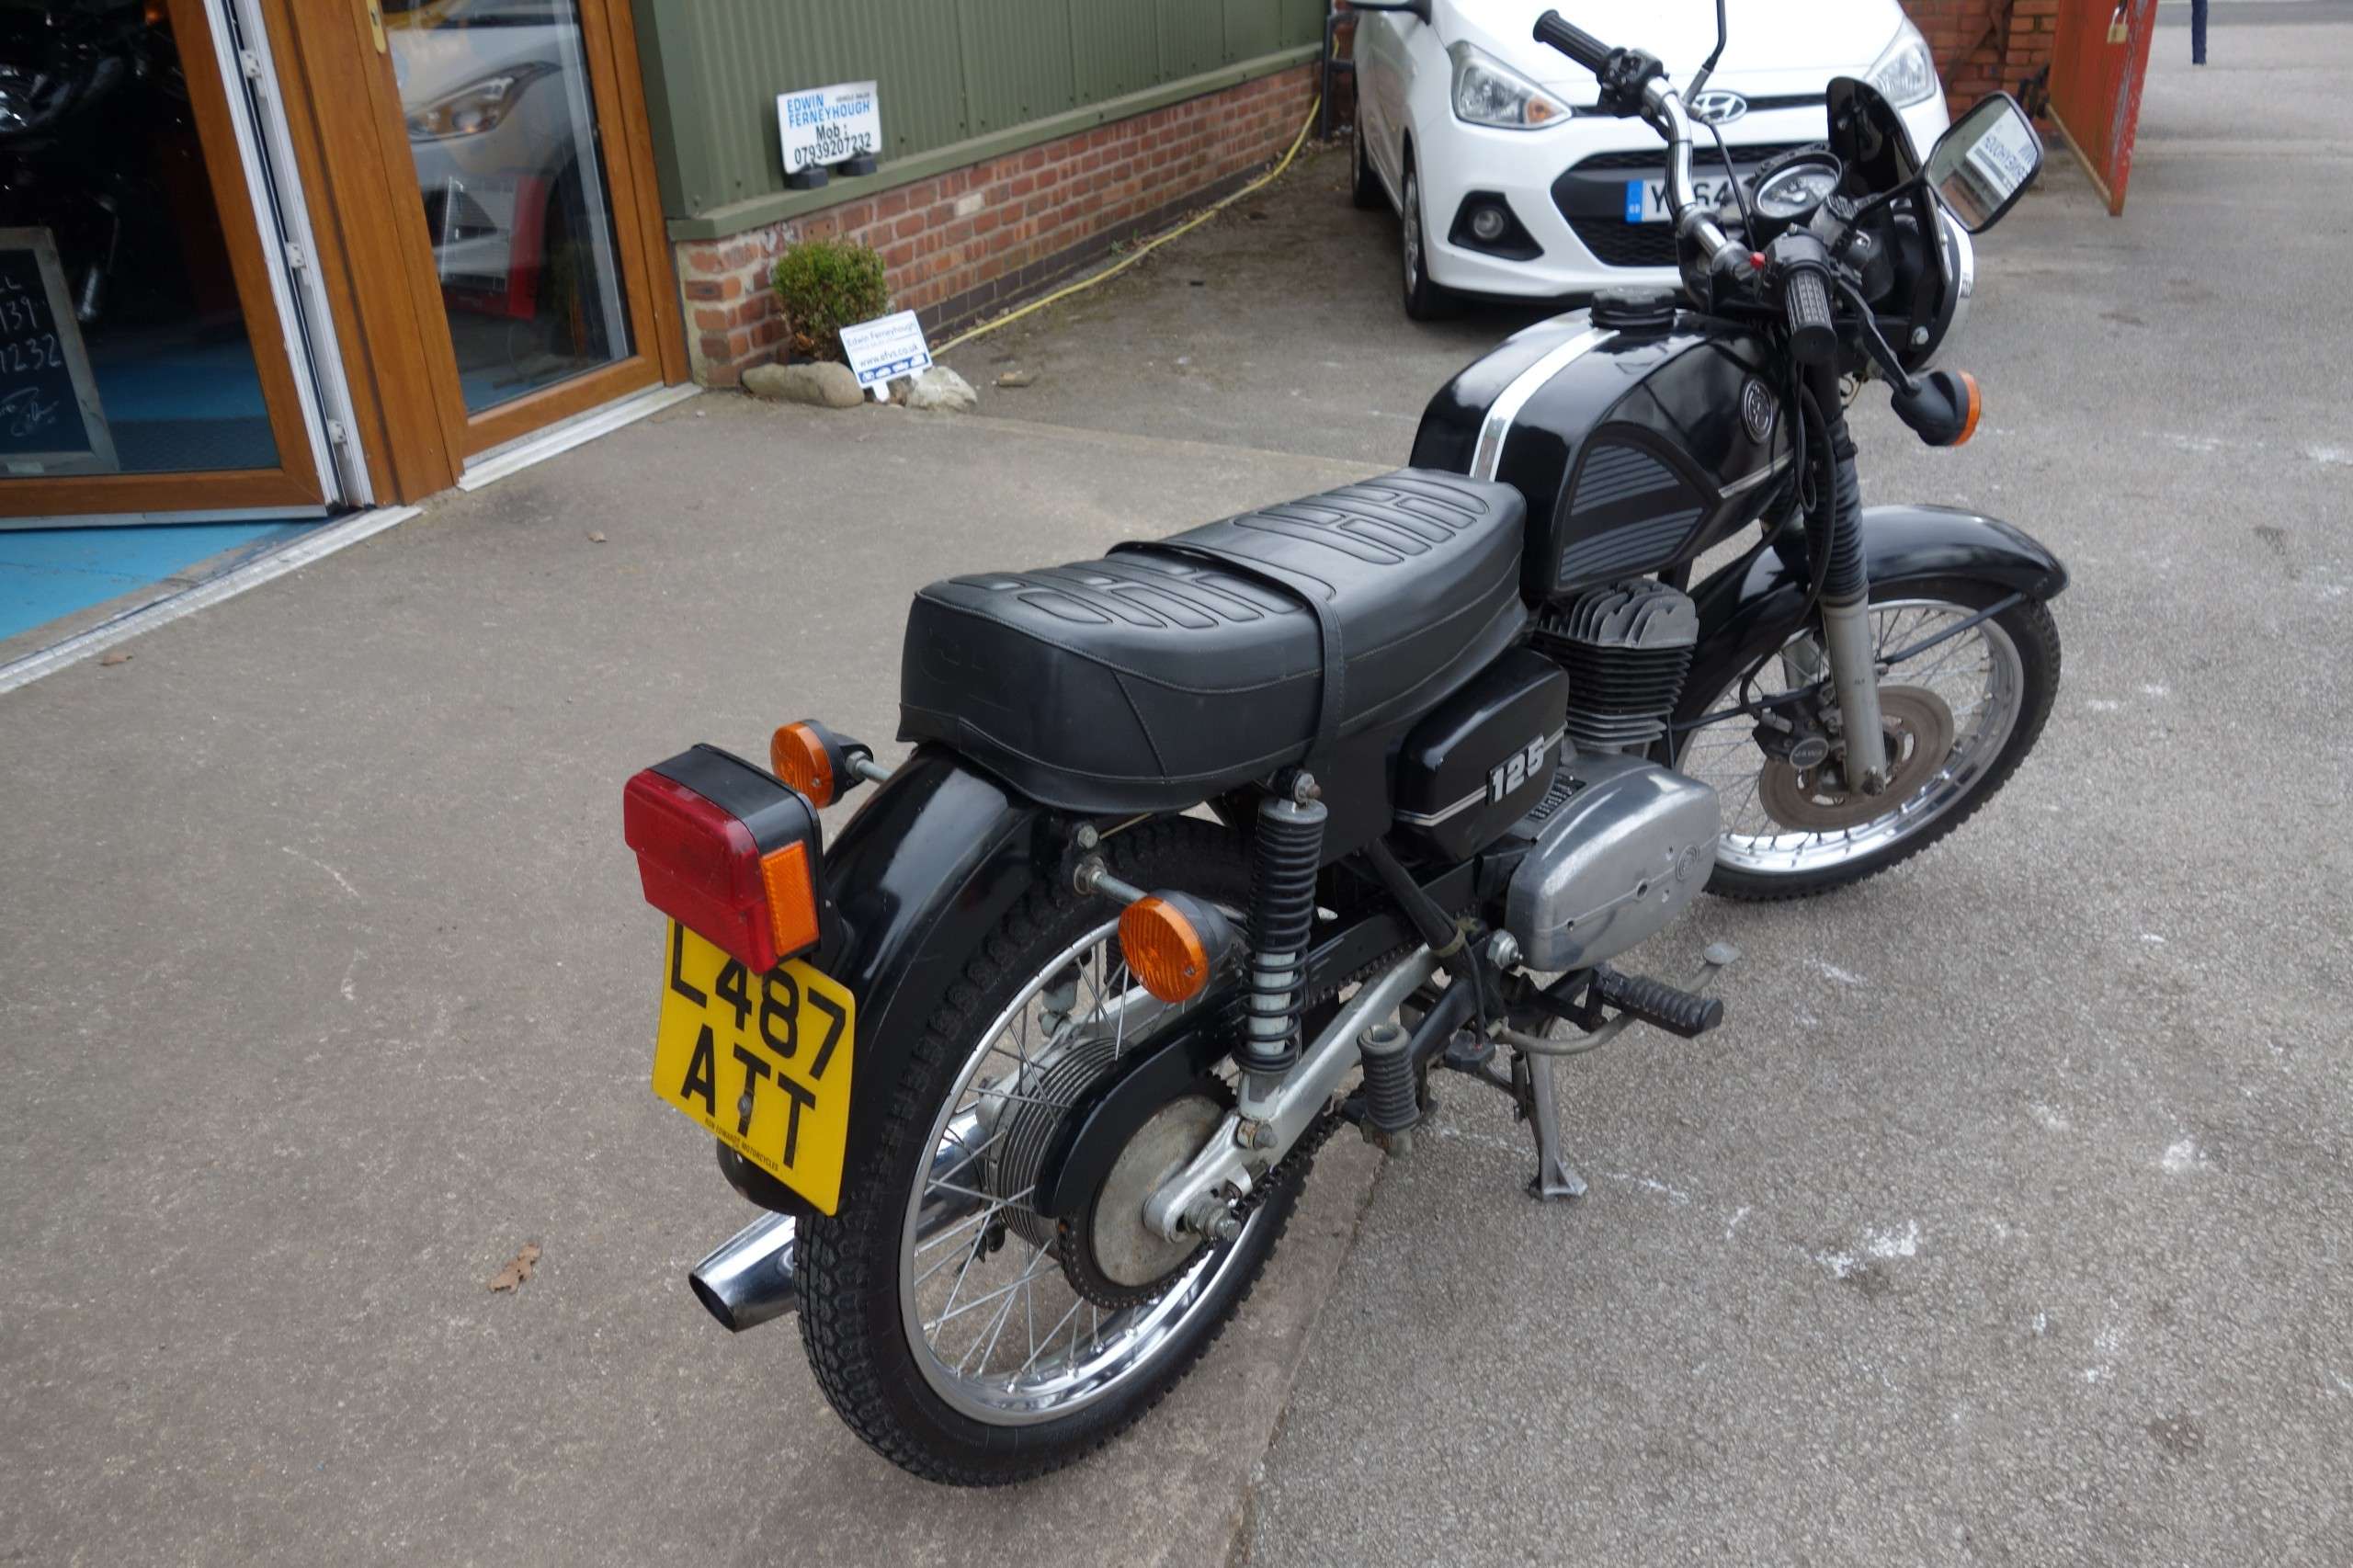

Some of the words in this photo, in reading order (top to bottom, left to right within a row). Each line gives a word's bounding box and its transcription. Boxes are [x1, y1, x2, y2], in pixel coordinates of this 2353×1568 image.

[787, 93, 824, 112] EDWIN
[789, 100, 870, 128] FERNEYHOUGH
[794, 131, 871, 165] 07939207232
[815, 122, 840, 142] Mob
[1651, 181, 1730, 213] Y64
[1489, 734, 1544, 802] 125
[670, 921, 847, 1081] L487
[680, 1023, 816, 1170] ATT
[741, 1141, 779, 1172] MOTORCYCLES
